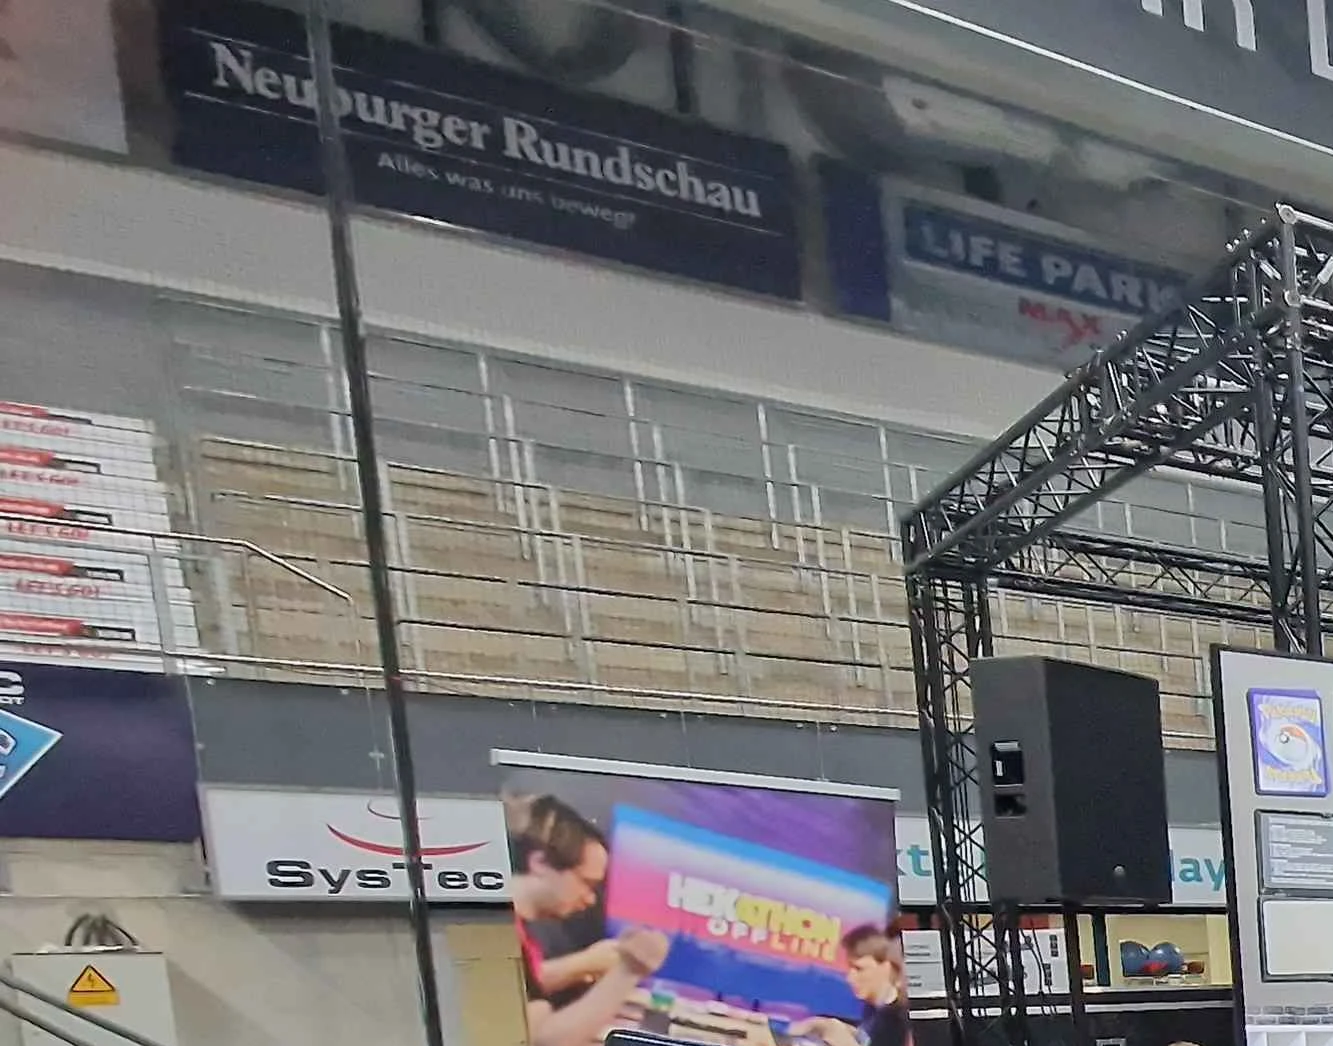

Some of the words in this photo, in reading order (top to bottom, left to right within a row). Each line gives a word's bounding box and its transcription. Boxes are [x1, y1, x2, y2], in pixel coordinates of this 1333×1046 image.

[377, 152, 440, 181] Alles
[444, 172, 495, 194] was
[502, 116, 763, 218] Rundschau
[919, 220, 1027, 278] LIFE
